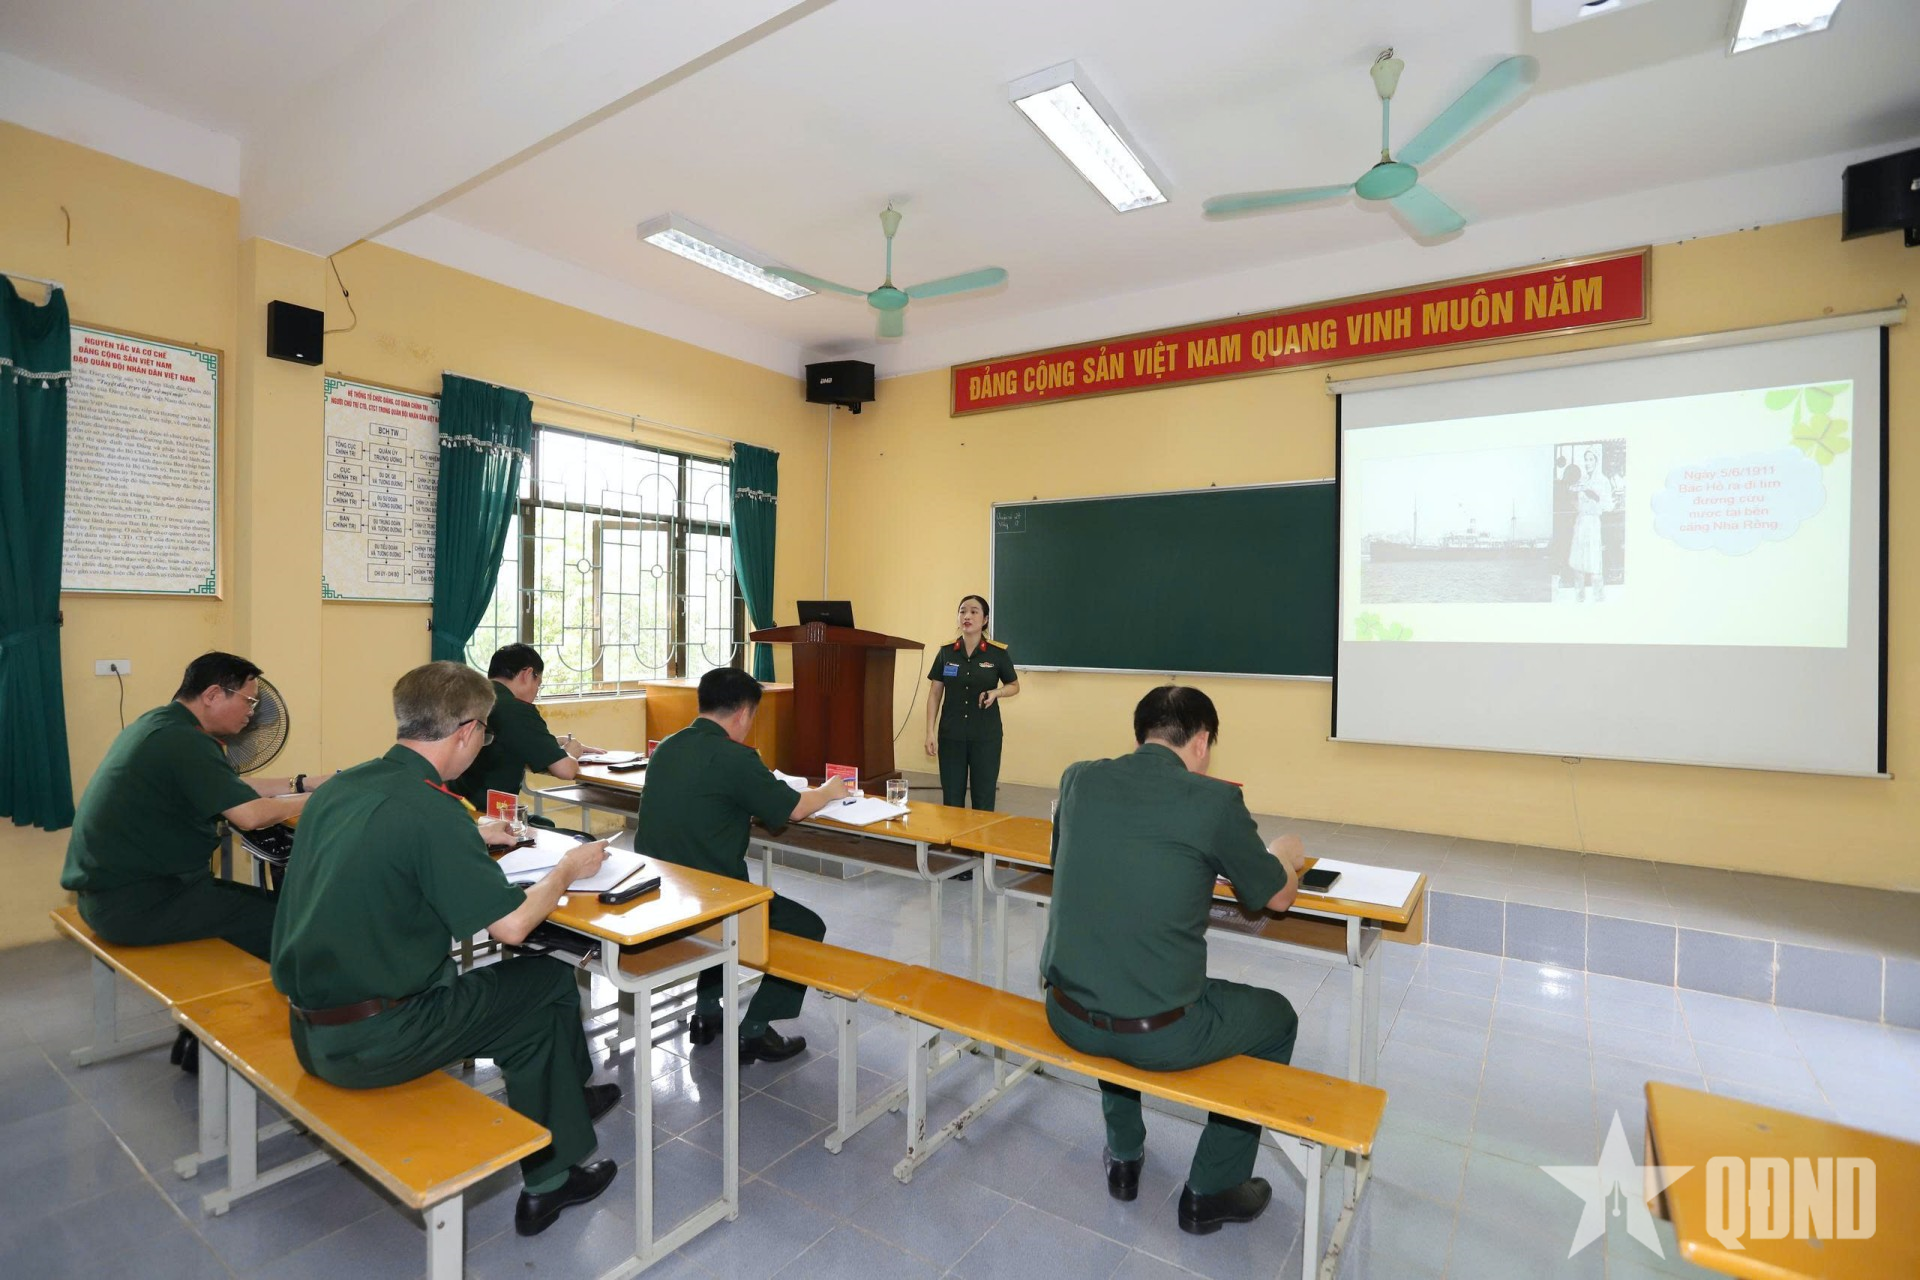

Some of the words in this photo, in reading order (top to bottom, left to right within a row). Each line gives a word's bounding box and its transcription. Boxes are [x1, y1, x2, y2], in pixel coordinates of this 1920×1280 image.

[969, 365, 1017, 401] ĐẢNG
[1023, 360, 1075, 396] CỘNG
[1082, 346, 1124, 384] SẢN
[1133, 341, 1178, 379] VIỆT
[1187, 334, 1241, 369] NAM
[1251, 318, 1337, 363] QUANG
[1347, 306, 1412, 346] VINH
[1422, 288, 1513, 335] MUÔN
[1525, 274, 1603, 321] NĂM
[156, 360, 172, 370] NAM
[180, 374, 196, 383] NAM
[378, 426, 390, 436] BCH
[1720, 465, 1776, 478] 5/6/1911
